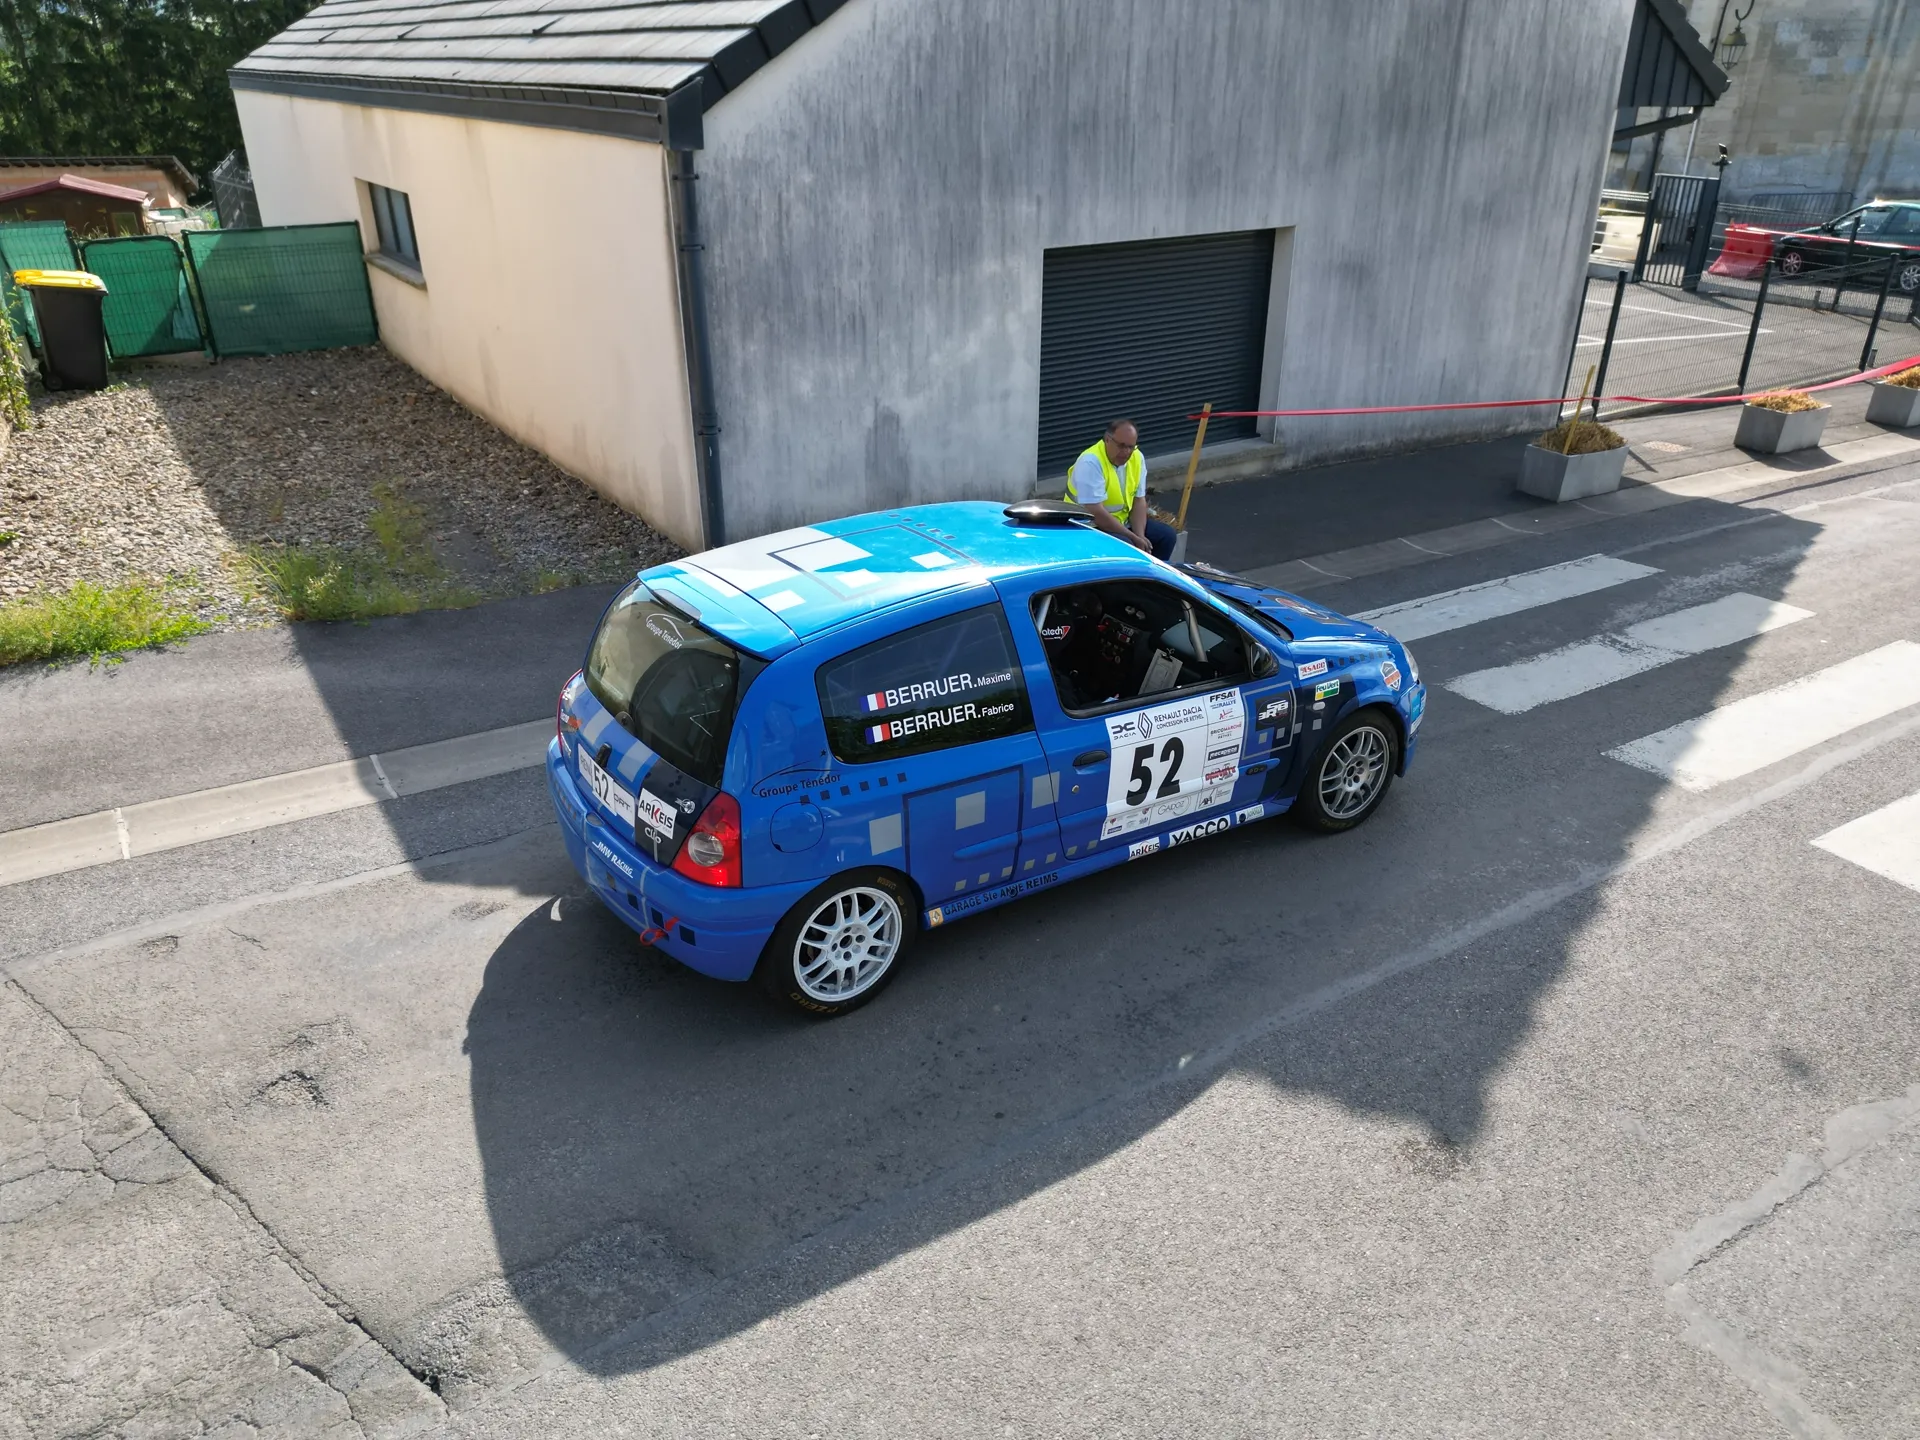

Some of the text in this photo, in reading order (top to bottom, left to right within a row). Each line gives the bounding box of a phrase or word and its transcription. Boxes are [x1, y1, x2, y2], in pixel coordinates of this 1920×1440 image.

[978, 672, 1011, 687] Maxime
[1316, 684, 1327, 692] Feu
[1209, 691, 1233, 703] FFSA
[982, 703, 1015, 717] Fabrice
[1154, 710, 1182, 723] RENAULT
[1182, 705, 1202, 716] DACIA
[1156, 719, 1184, 730] CONCESSION
[1113, 732, 1137, 740] DACIA
[1126, 737, 1185, 807] 52
[593, 765, 611, 807] 52
[759, 783, 798, 799] Groupe
[639, 799, 674, 830] ARKEIS
[1171, 817, 1229, 845] YACCO
[1130, 843, 1160, 858] ARKEIS
[611, 855, 634, 876] RACING
[943, 897, 981, 916] GARAGE
[1026, 872, 1058, 890] REIMS
